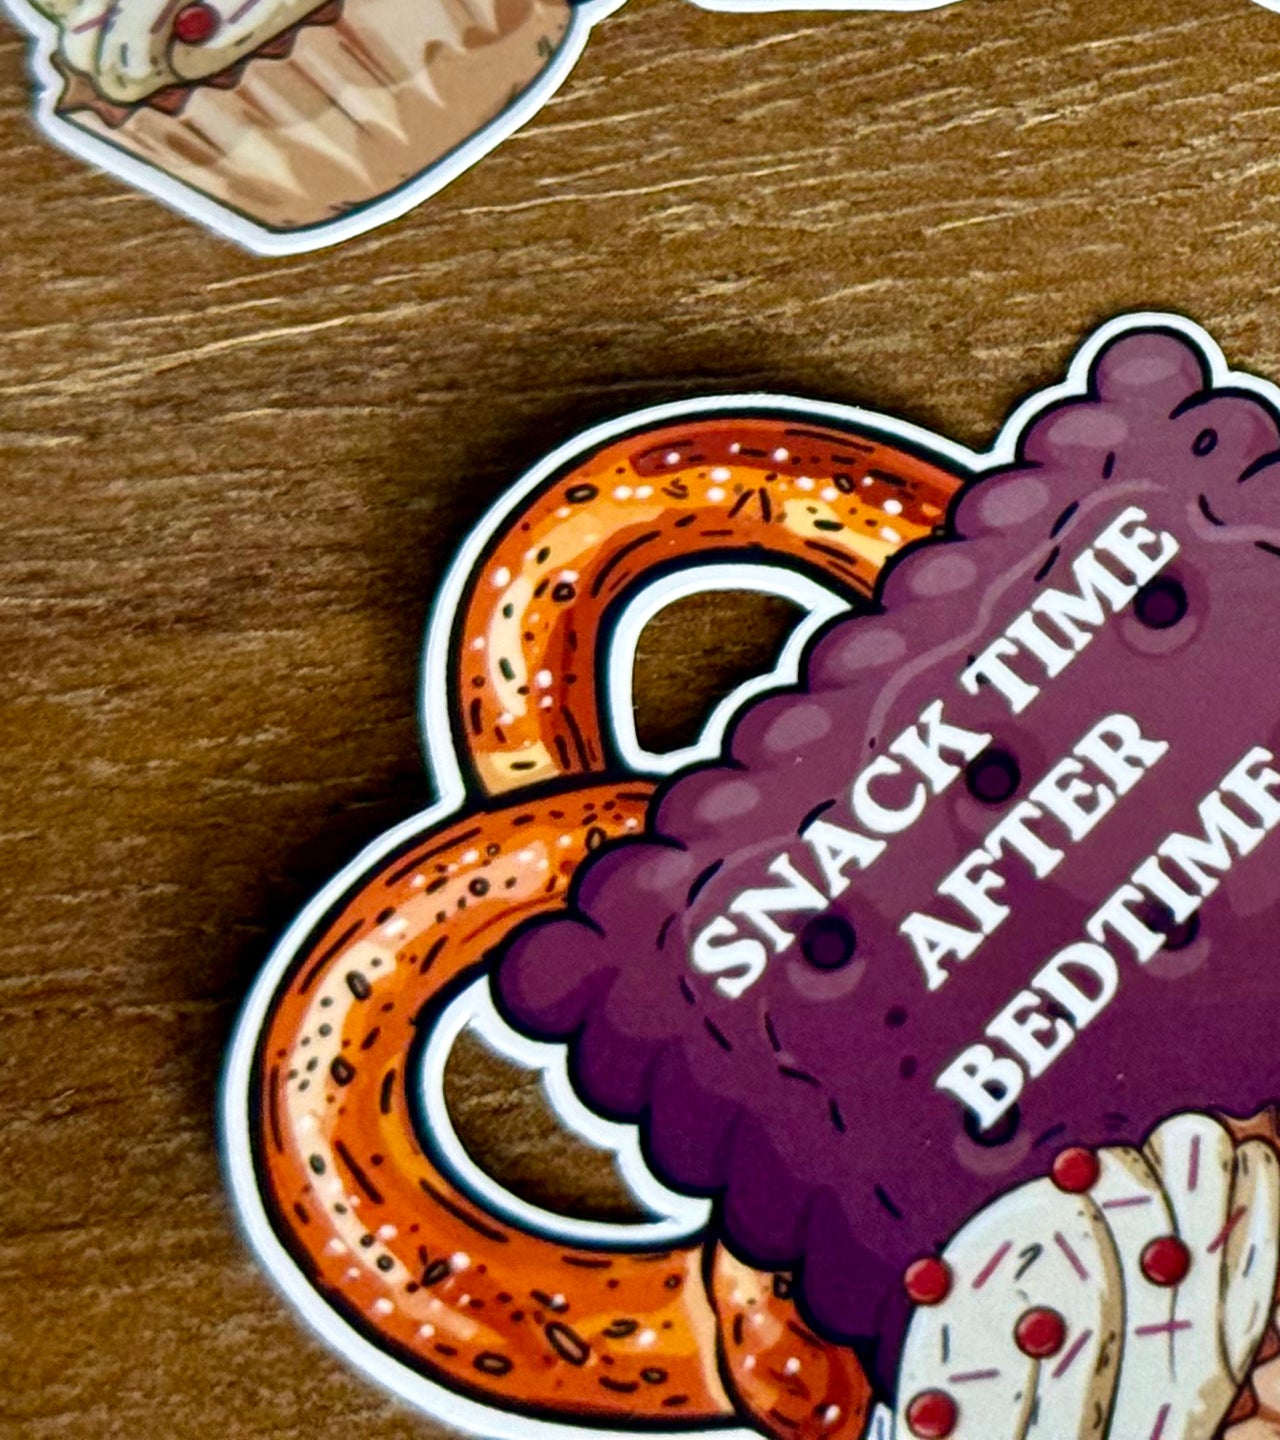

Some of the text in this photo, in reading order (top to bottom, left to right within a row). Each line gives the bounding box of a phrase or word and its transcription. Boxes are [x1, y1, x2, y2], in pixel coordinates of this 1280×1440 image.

[690, 504, 1182, 1000] SNACK TIME
[898, 712, 1171, 992] AFTER
